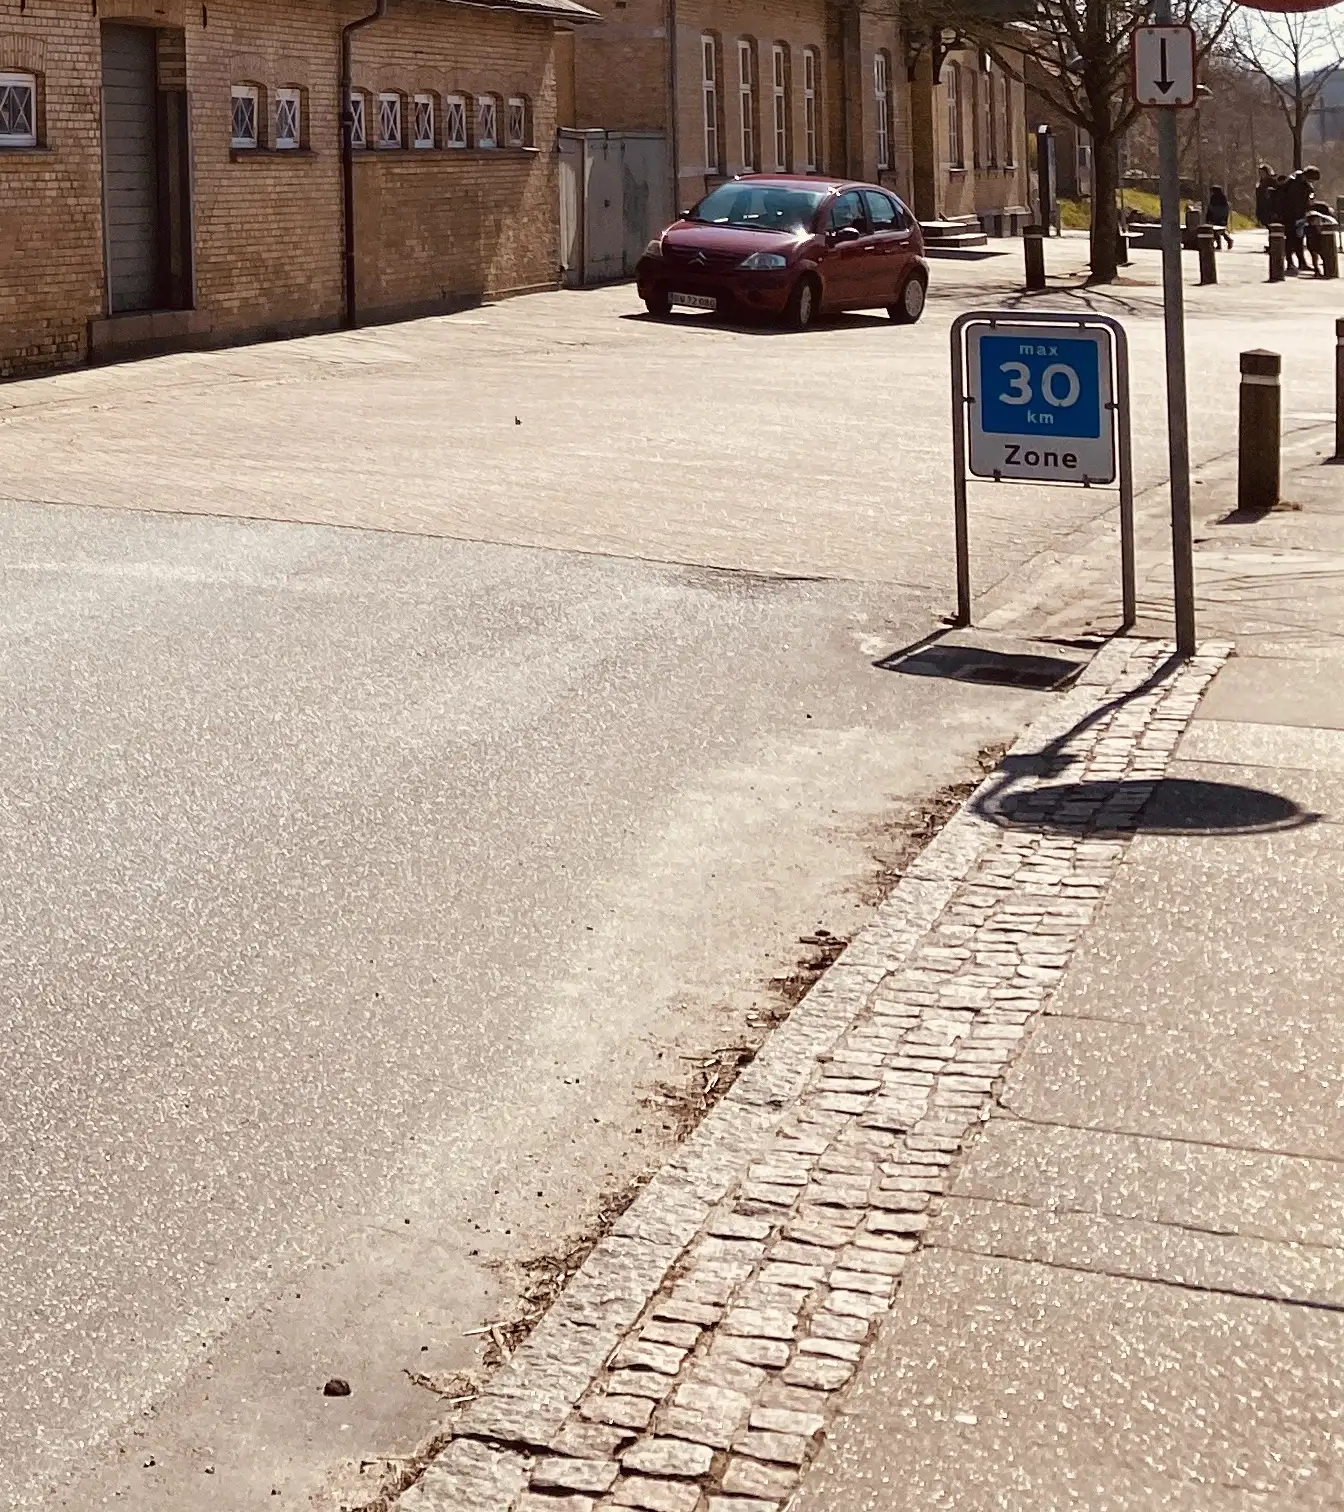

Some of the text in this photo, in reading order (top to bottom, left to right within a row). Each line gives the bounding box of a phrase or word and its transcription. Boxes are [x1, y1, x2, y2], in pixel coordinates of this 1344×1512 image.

[1019, 344, 1059, 357] max
[998, 361, 1081, 408] 30
[1027, 410, 1054, 424] km
[1004, 444, 1078, 469] Zone
